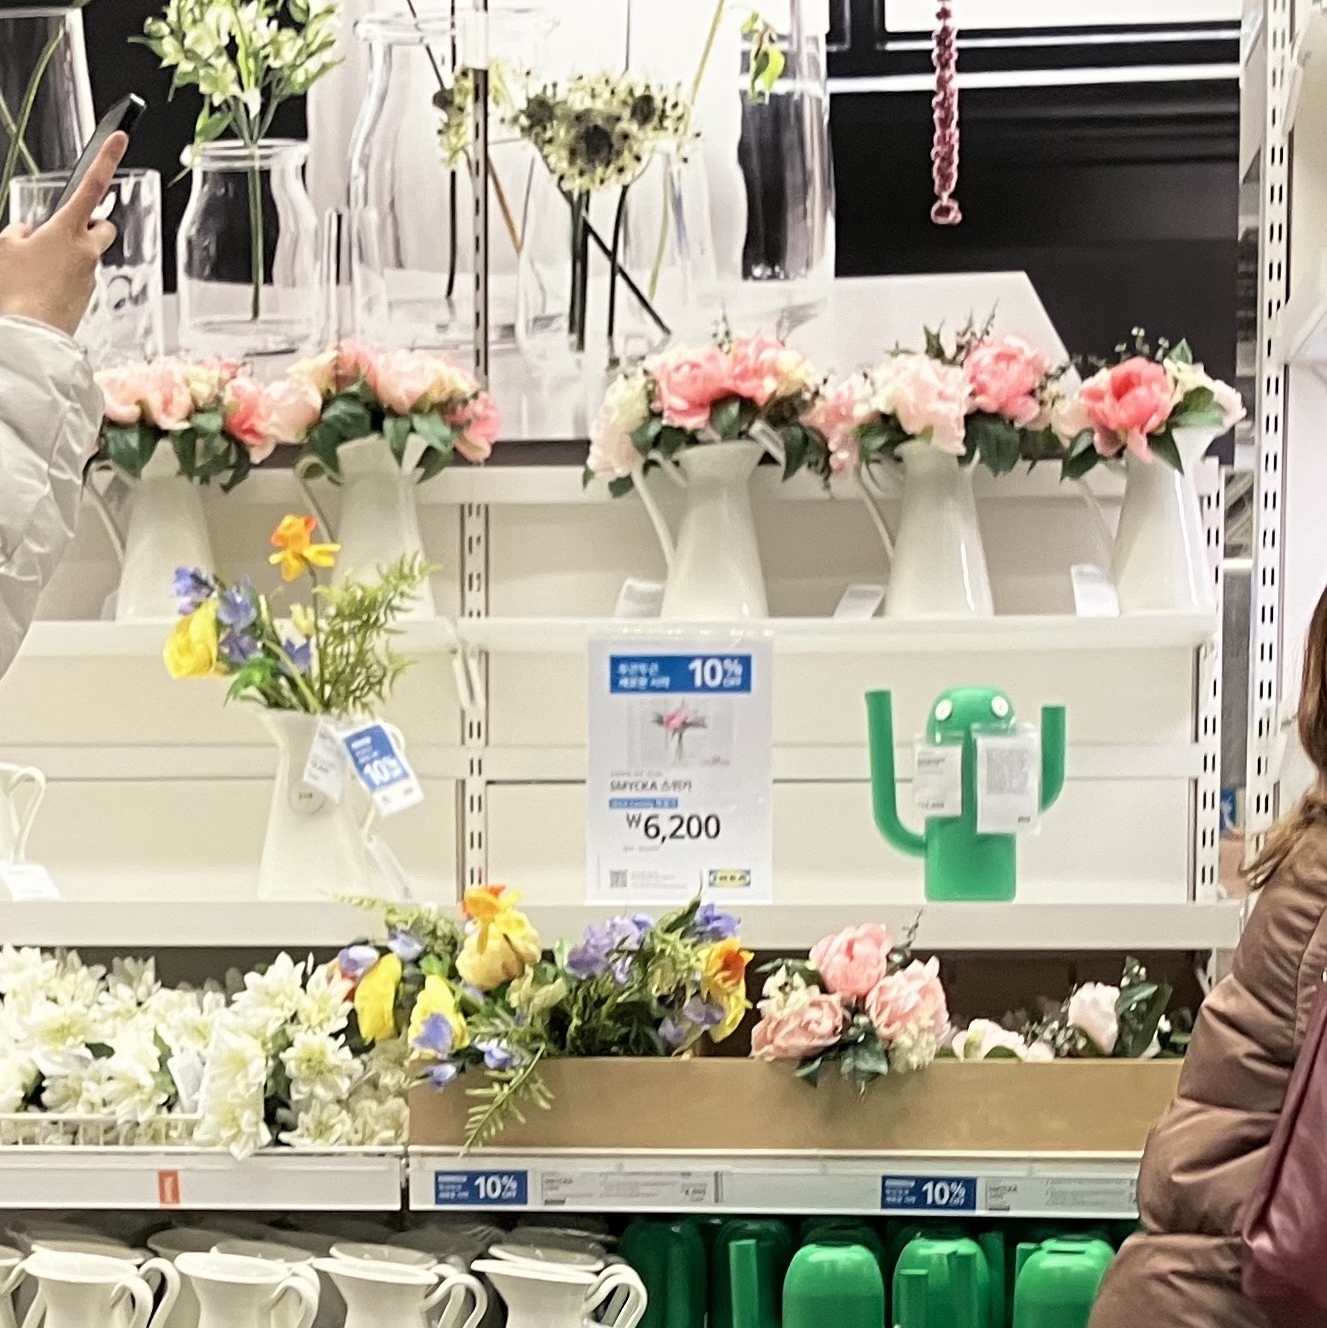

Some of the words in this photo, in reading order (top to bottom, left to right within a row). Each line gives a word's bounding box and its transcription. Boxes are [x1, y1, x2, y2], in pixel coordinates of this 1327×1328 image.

[688, 658, 743, 688] 10%
[474, 1174, 518, 1199] 10%
[921, 1180, 966, 1206] 10%
